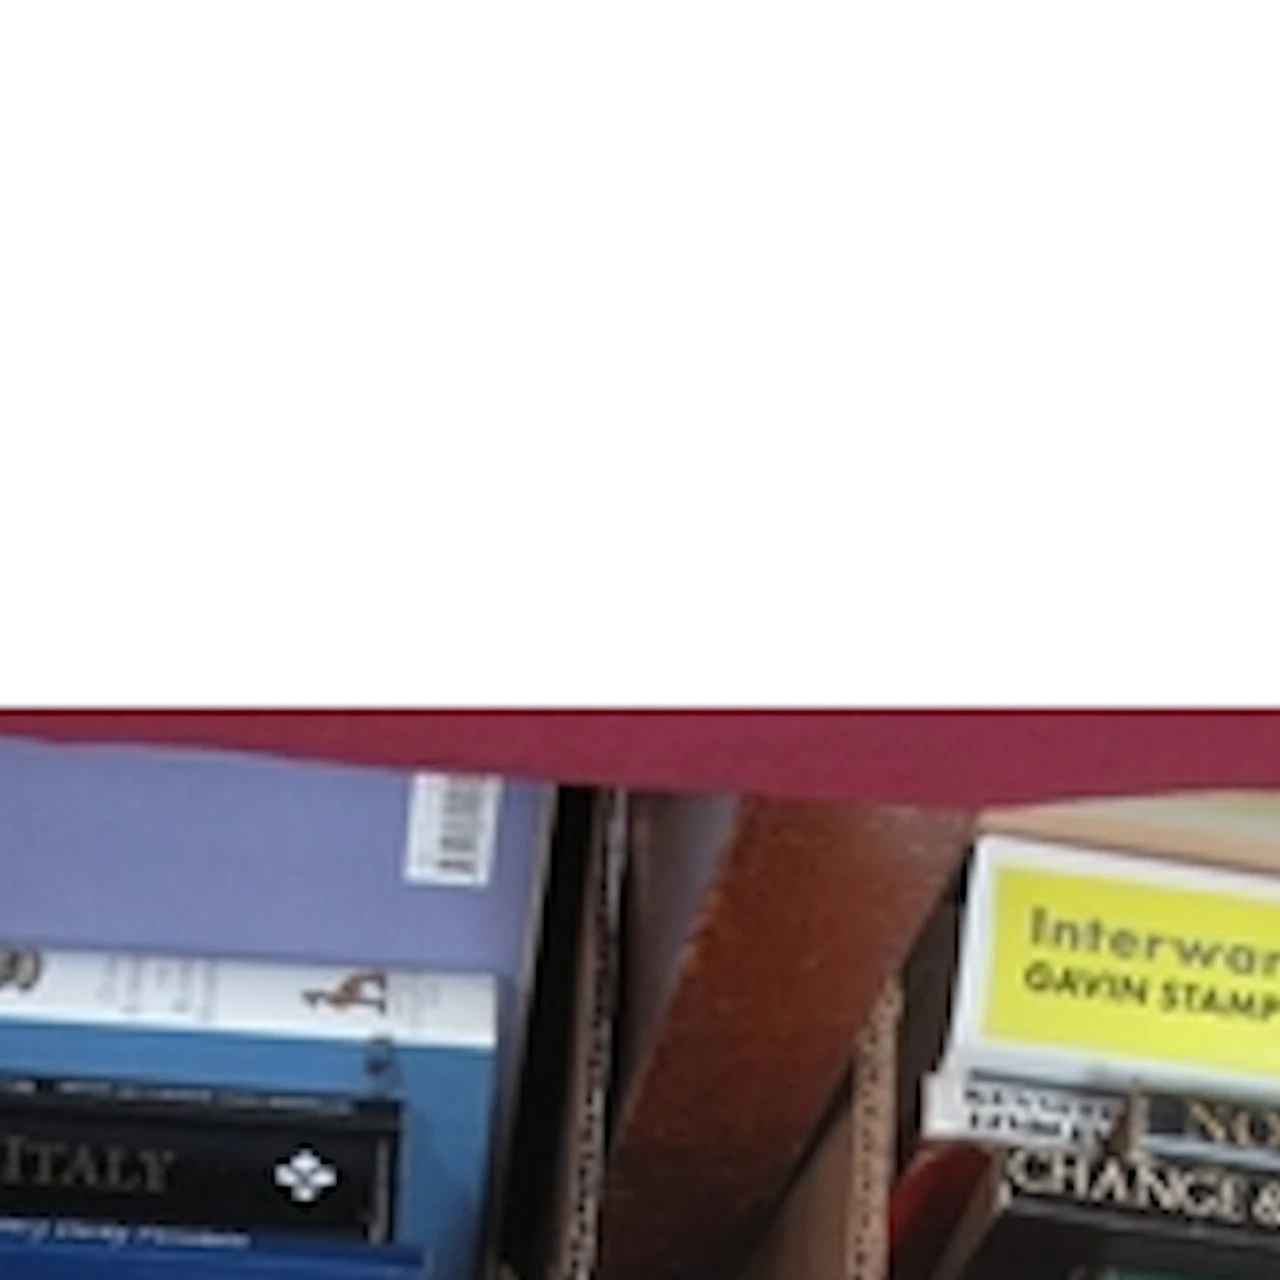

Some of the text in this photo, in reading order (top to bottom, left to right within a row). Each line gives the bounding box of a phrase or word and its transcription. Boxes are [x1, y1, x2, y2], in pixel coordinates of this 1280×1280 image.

[1024, 960, 1148, 1008] GAVIN
[0, 1133, 177, 1194] ITALY
[1005, 1147, 1245, 1227] CHANGE
